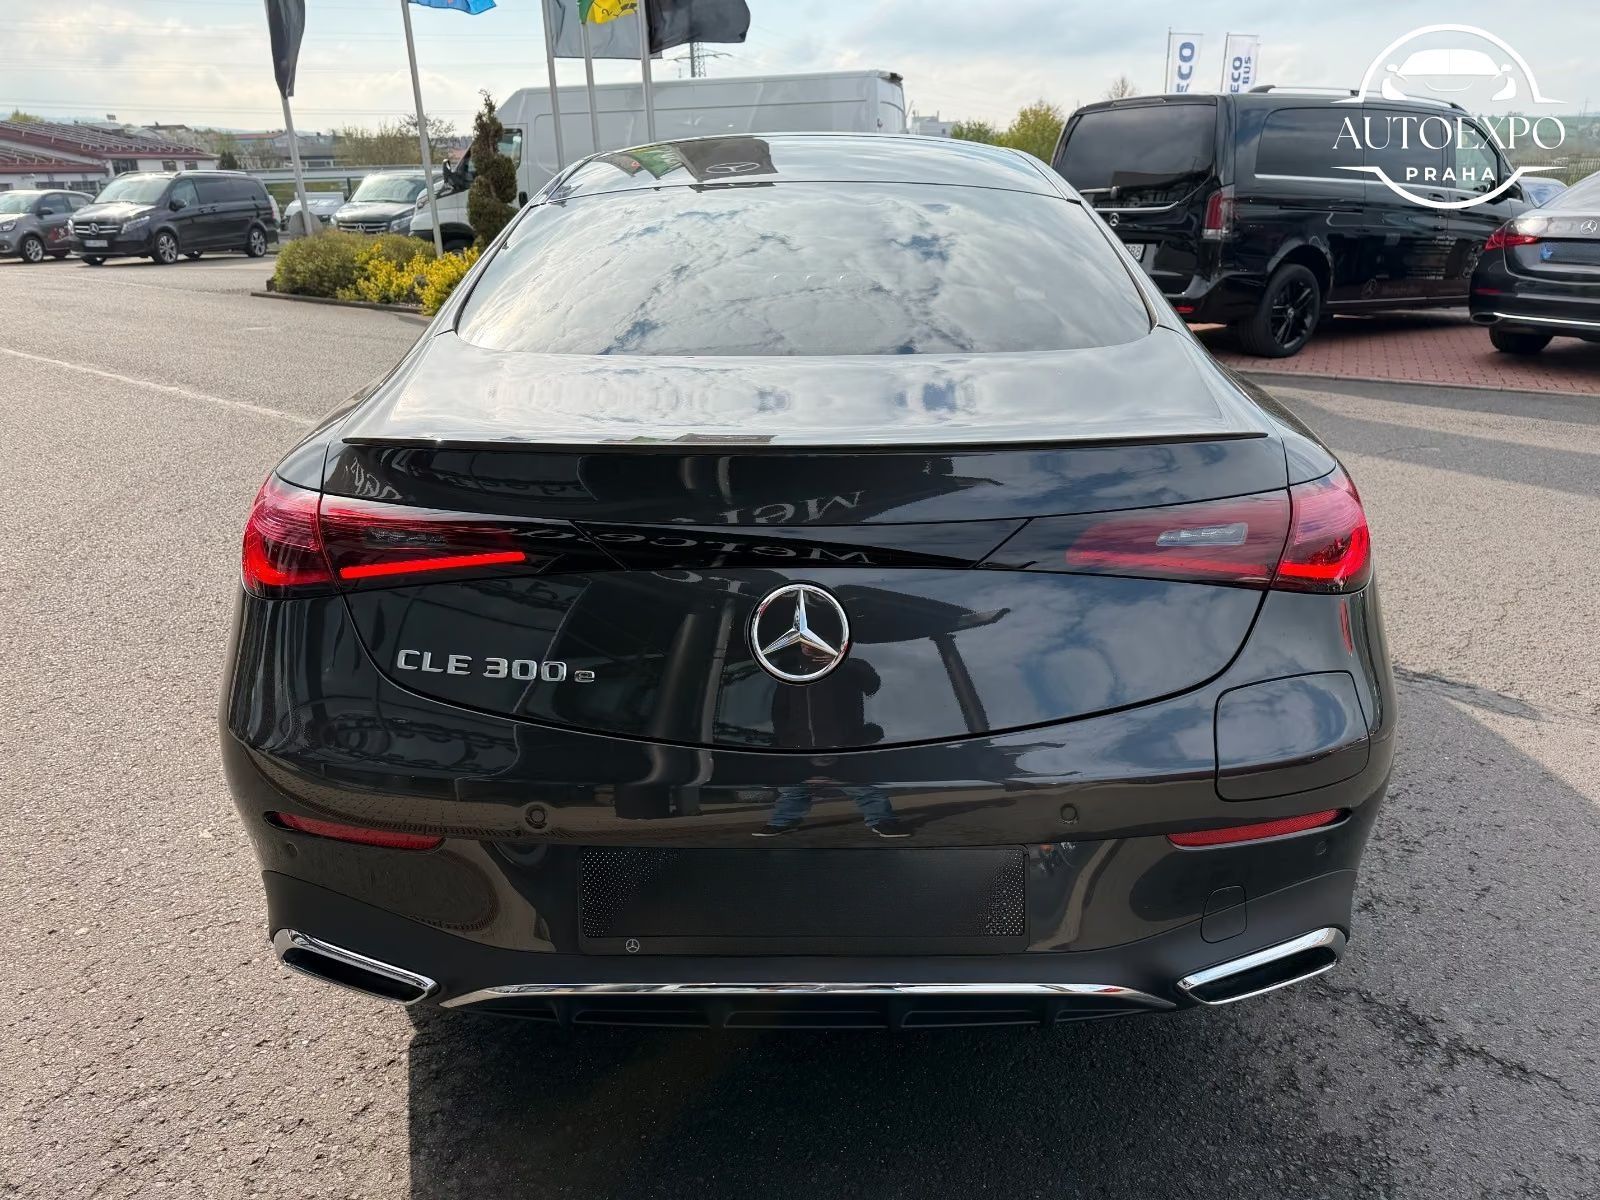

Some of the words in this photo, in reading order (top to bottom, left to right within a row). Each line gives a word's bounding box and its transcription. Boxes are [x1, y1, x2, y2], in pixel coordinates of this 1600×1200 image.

[1242, 56, 1252, 84] BUS
[397, 649, 472, 675] CLE
[483, 657, 568, 682] 300
